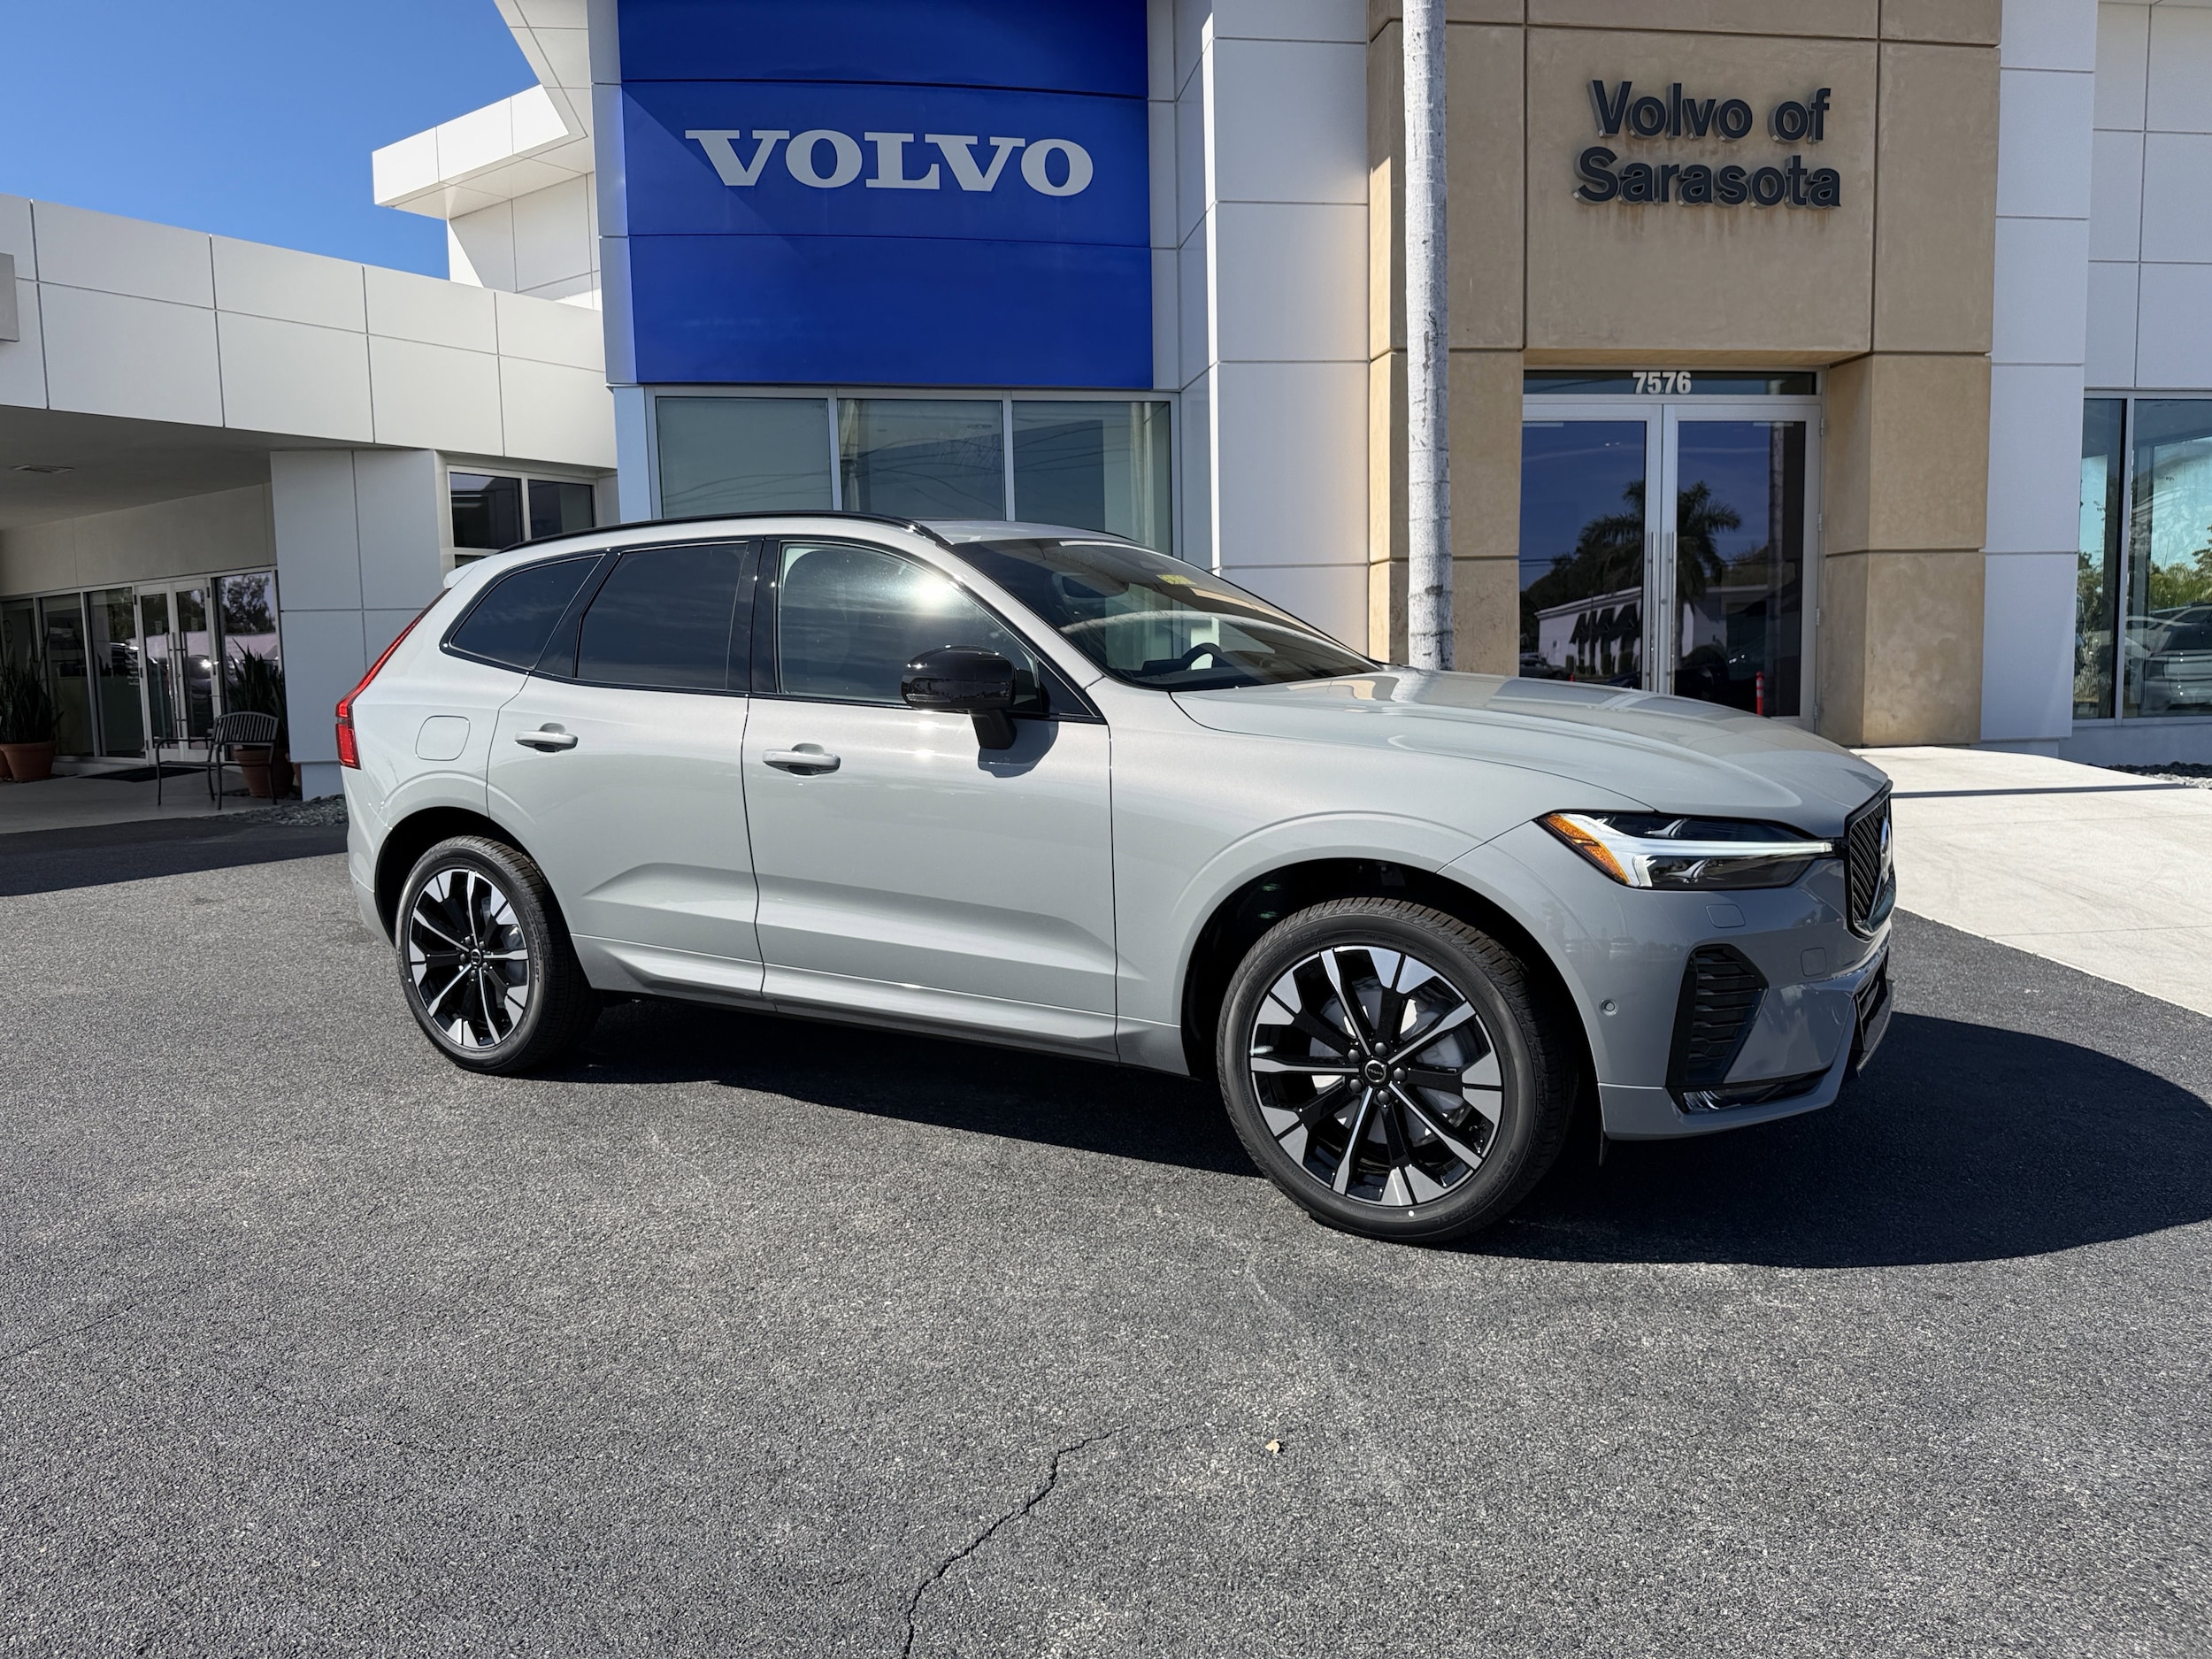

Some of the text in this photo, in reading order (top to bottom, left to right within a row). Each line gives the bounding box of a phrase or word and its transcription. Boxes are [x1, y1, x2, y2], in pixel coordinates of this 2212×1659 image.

[1590, 80, 1831, 143] Volvo of
[685, 128, 1094, 196] VOLVO
[1573, 146, 1841, 210] Sarasota
[1632, 372, 1692, 395] 7576
